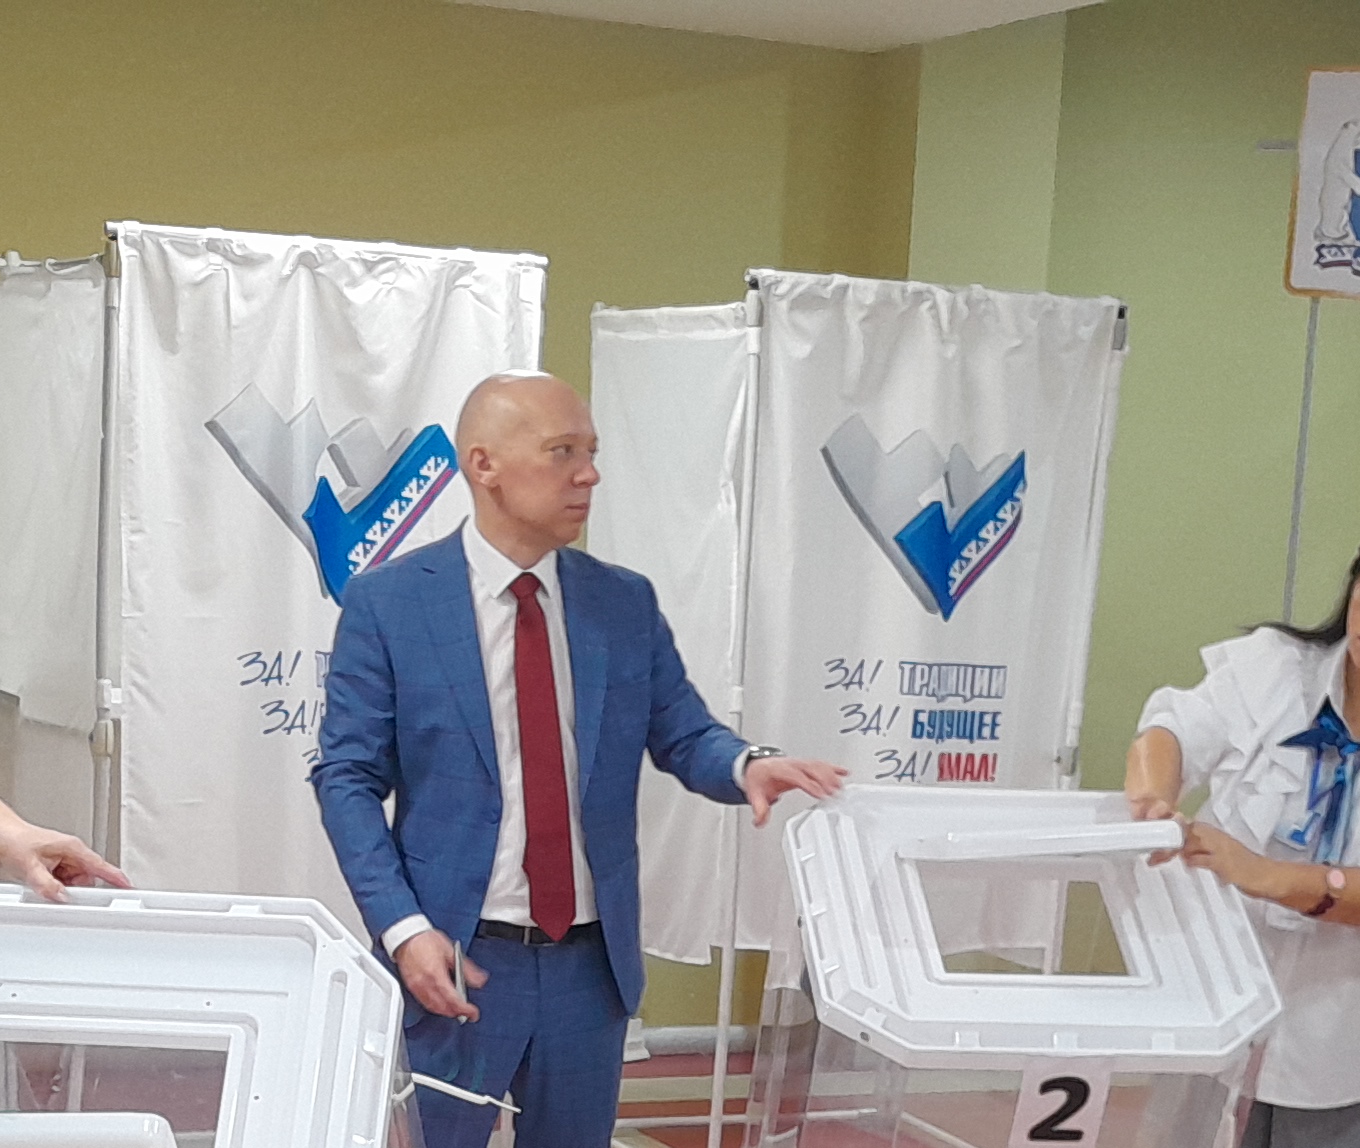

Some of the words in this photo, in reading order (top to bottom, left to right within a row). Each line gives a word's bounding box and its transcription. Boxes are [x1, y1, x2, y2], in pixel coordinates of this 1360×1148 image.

[237, 650, 301, 687] ЗА!
[824, 658, 884, 692] ЗА!
[899, 661, 1007, 703] ТРАЦИИ
[260, 700, 319, 736] ЗА!
[840, 703, 900, 737] ЗА!
[874, 749, 933, 782] ЗА!
[1027, 1076, 1091, 1141] 2
